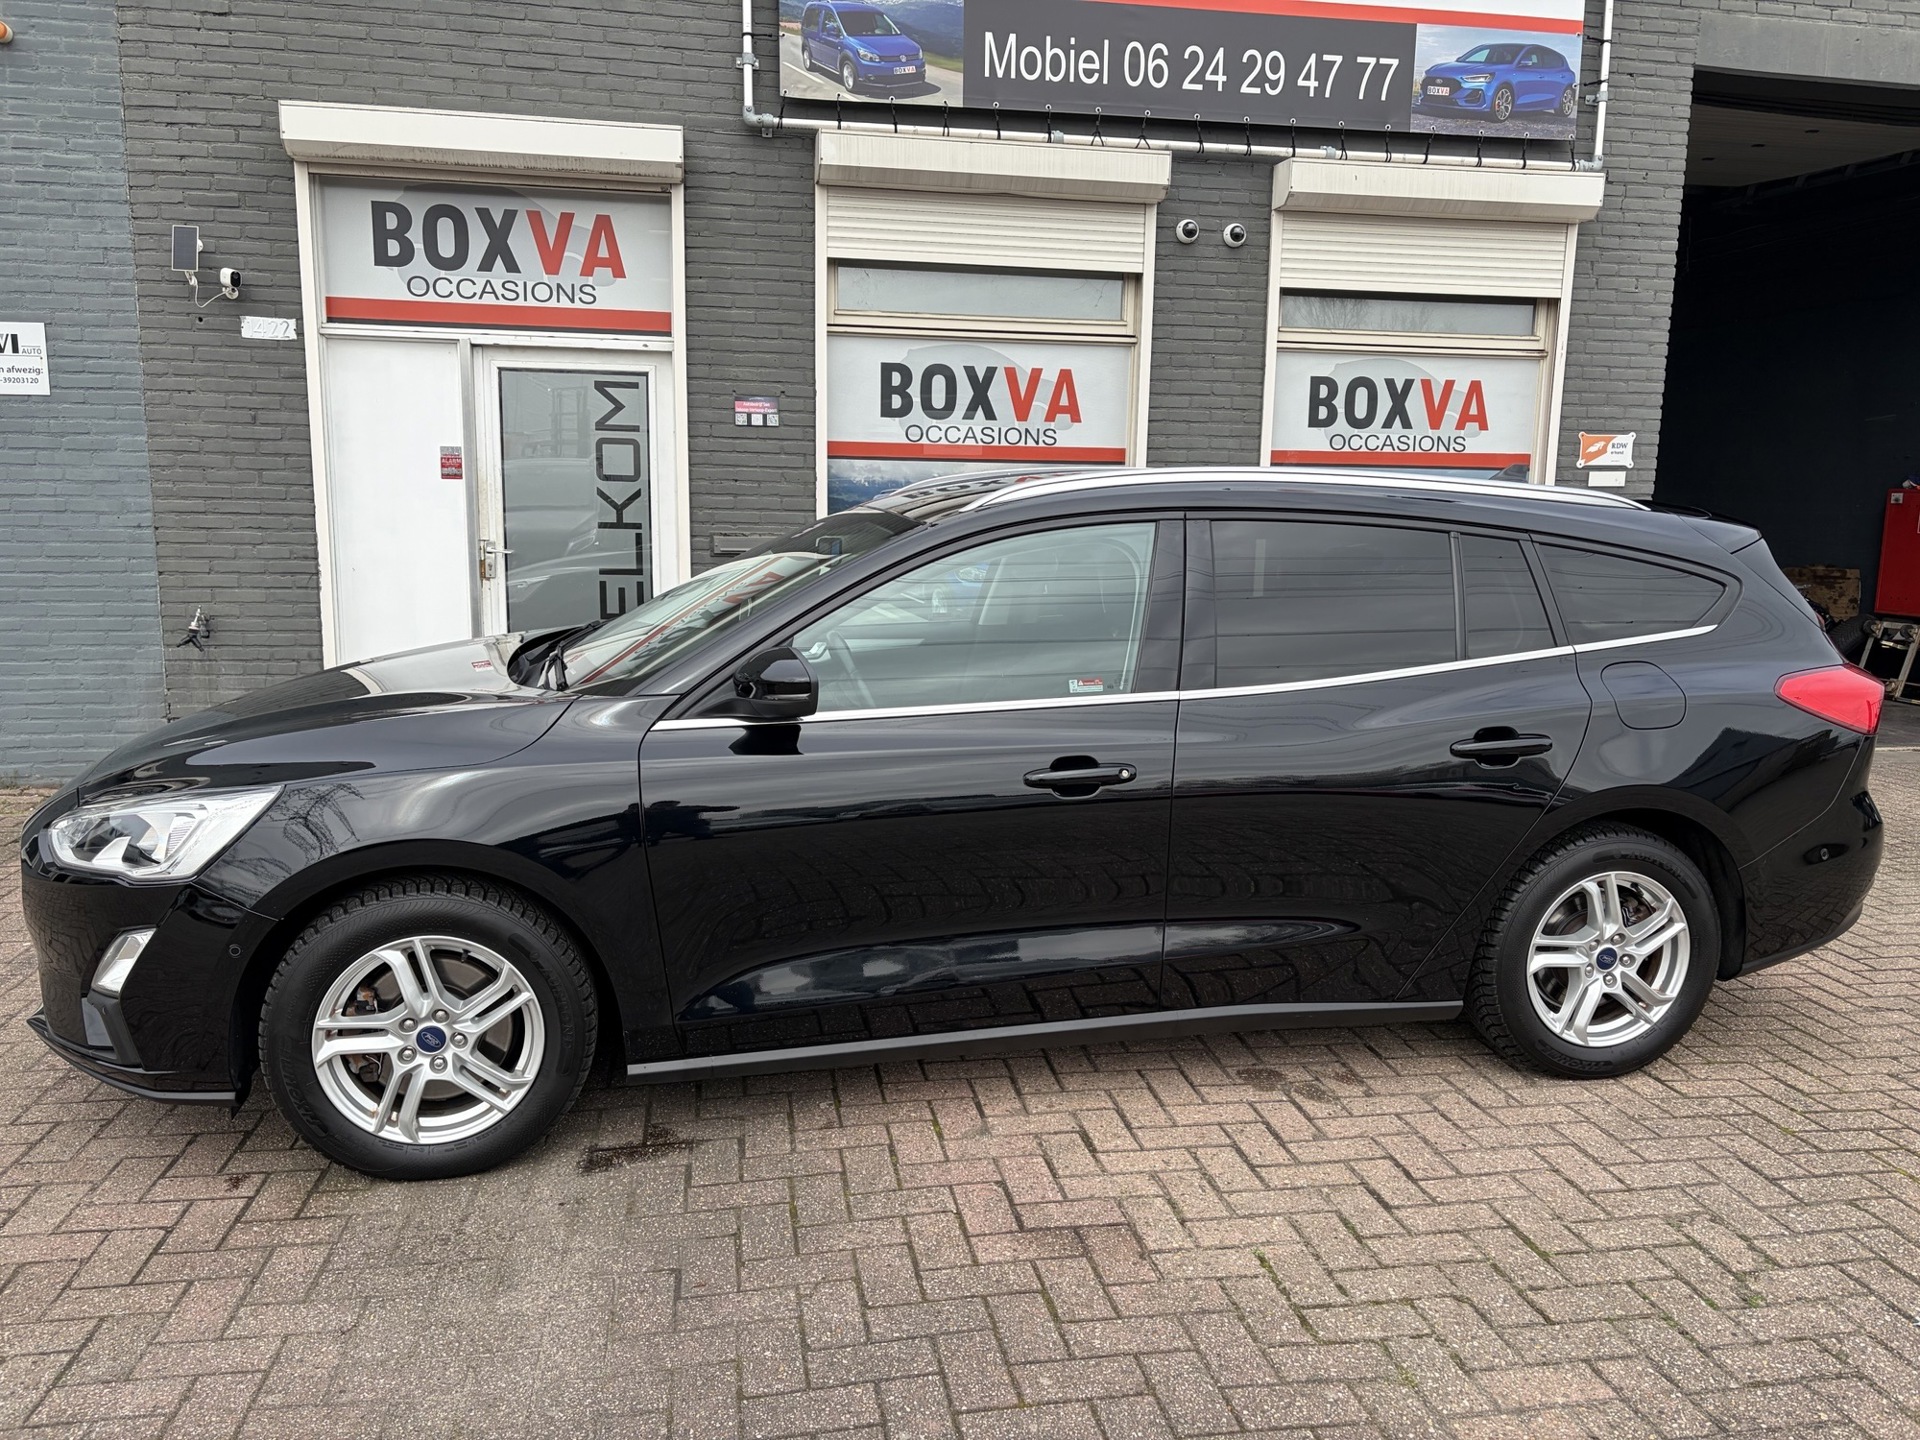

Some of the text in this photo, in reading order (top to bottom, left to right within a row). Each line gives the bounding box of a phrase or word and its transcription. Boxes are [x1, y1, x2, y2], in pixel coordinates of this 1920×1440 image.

[894, 66, 916, 74] BOXVA
[984, 31, 1400, 101] Mobiel 06 24 29 47 77
[1427, 86, 1449, 95] BOXVA
[370, 199, 627, 279] BOXVA
[406, 275, 597, 305] OCCASIONS
[6, 365, 44, 376] afwezig:
[880, 361, 1082, 423] BOXVA
[1307, 375, 1489, 432] BOXVA
[905, 424, 1057, 446] OCCASIONS
[1329, 434, 1467, 453] OCCASIONS
[594, 380, 645, 620] ELKOM
